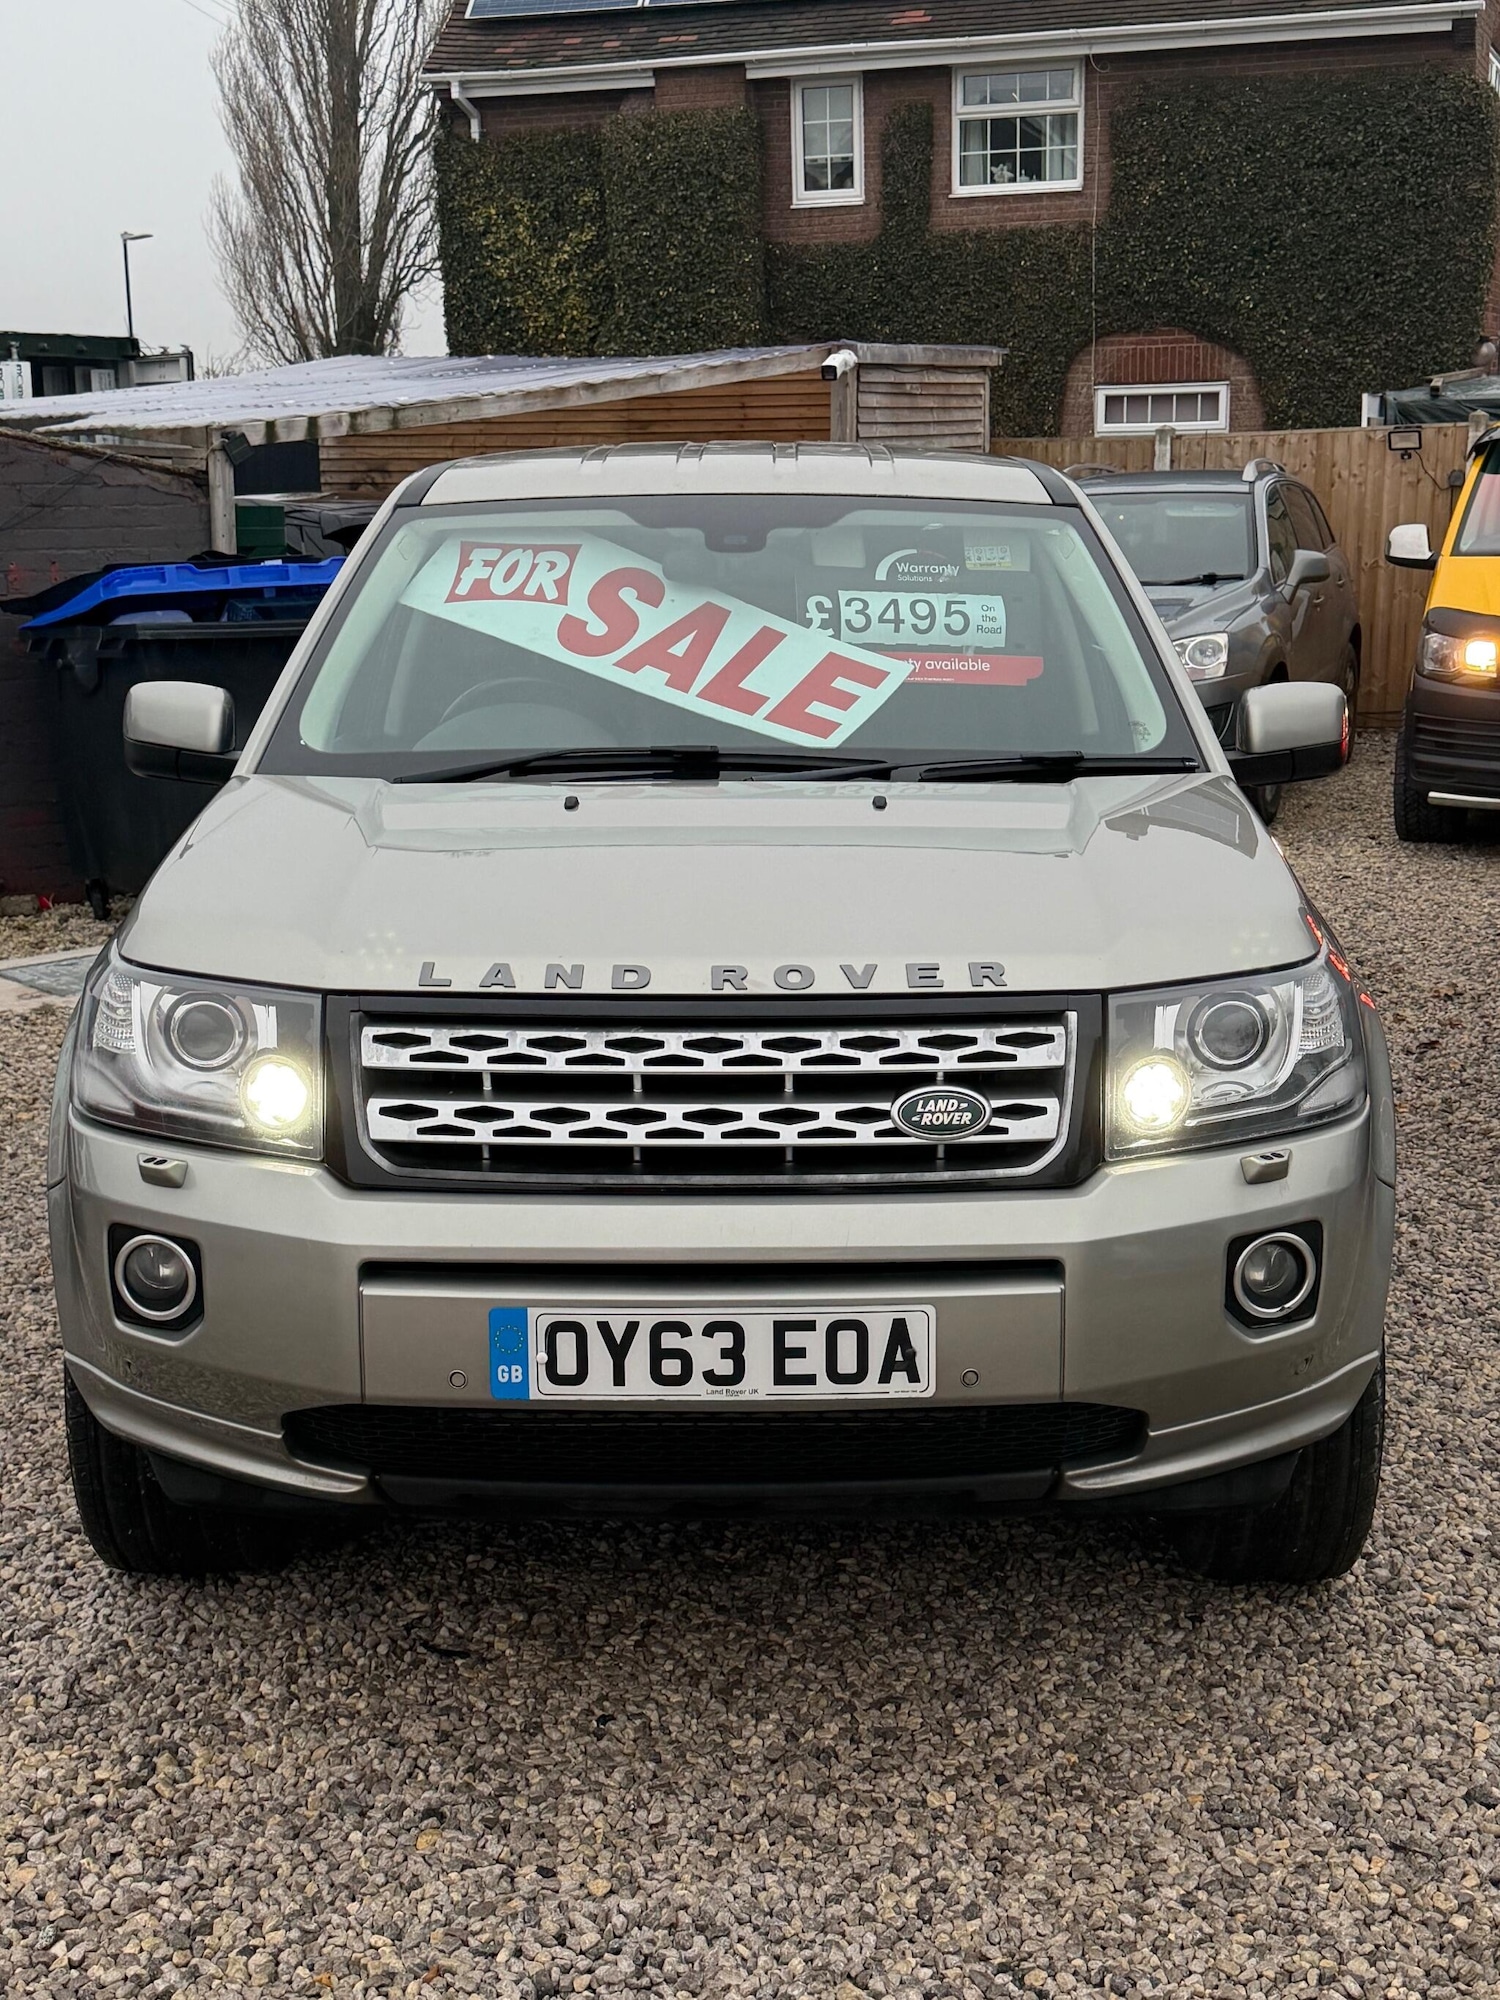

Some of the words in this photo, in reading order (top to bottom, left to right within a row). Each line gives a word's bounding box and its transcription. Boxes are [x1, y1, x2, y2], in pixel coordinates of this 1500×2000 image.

[455, 549, 570, 600] FOR
[896, 562, 959, 576] Warranty
[982, 614, 997, 622] the
[976, 625, 1002, 634] Road
[557, 567, 890, 739] SALE
[925, 658, 991, 671] available
[418, 961, 651, 990] LAND
[711, 960, 1008, 991] ROVER
[916, 1099, 958, 1112] LAND
[921, 1112, 972, 1125] ROVER
[545, 1320, 746, 1387] OY63
[773, 1318, 921, 1386] EOA
[498, 1365, 523, 1383] GB
